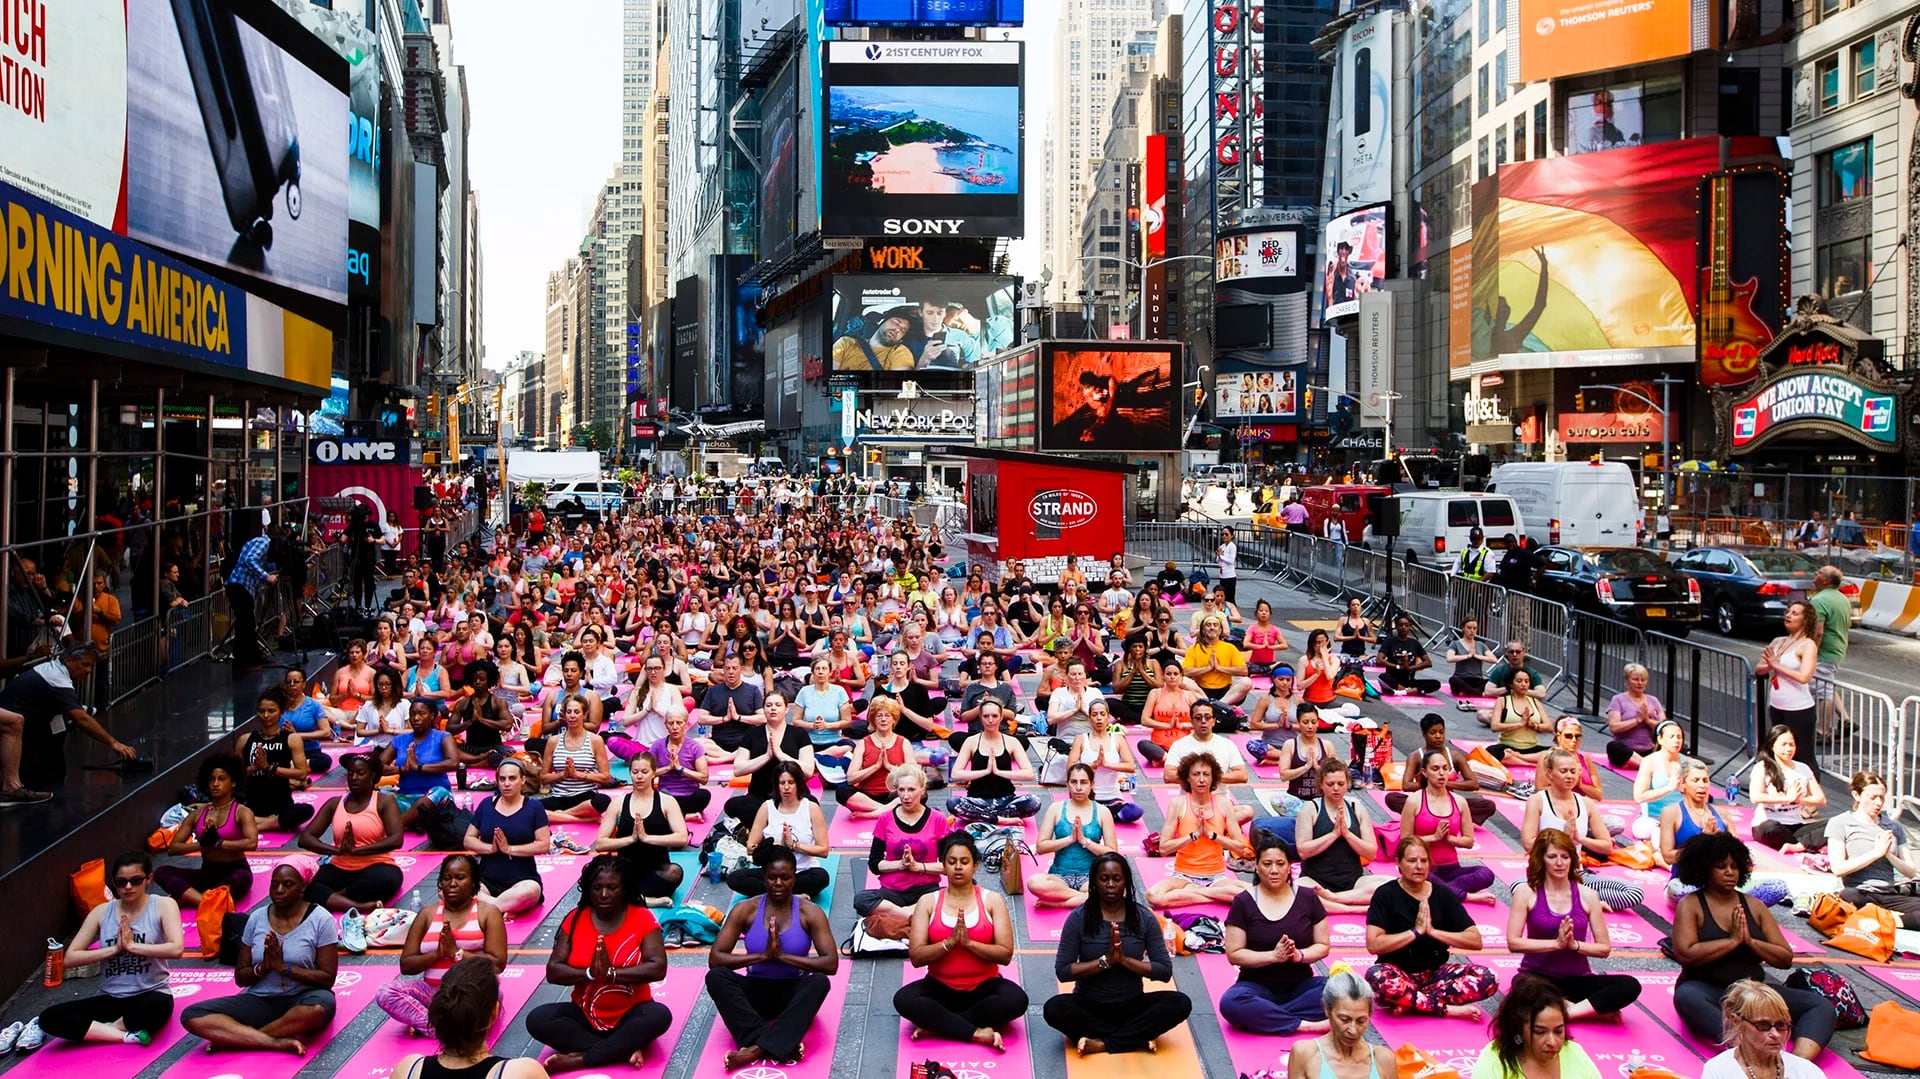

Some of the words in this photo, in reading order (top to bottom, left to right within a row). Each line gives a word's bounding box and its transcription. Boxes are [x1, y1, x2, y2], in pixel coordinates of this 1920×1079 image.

[1560, 11, 1606, 27] THOMSON
[1608, 1, 1652, 18] REUTERS
[0, 0, 46, 68] TCH
[1352, 26, 1375, 41] RICOH
[886, 48, 910, 57] 21ST
[911, 48, 961, 57] CENTURY
[962, 48, 983, 57] FOX
[1353, 153, 1373, 168] THETA
[883, 218, 964, 234] SONY
[824, 240, 862, 248] SHERWOOD
[1261, 240, 1279, 248] RED
[869, 246, 924, 269] WORK
[1262, 256, 1279, 264] DAY
[127, 254, 231, 355] AMERICA
[1371, 312, 1380, 347] REUTERS
[1788, 344, 1812, 364] Hard
[1814, 342, 1840, 364] Rock
[1371, 349, 1380, 388] THOMSON
[1757, 387, 1777, 413] WE
[1777, 375, 1810, 401] NOW
[1812, 375, 1864, 407] ACCEPT
[1771, 395, 1817, 422] UNION
[1817, 395, 1845, 419] PAY
[856, 408, 891, 428] NEW
[892, 408, 935, 429] YORK
[1567, 427, 1616, 439] europa
[342, 441, 396, 460] NYC
[1342, 438, 1383, 448] CHASE
[1033, 502, 1094, 515] STRAND
[1303, 778, 1316, 786] HER
[108, 955, 148, 966] SLEEP
